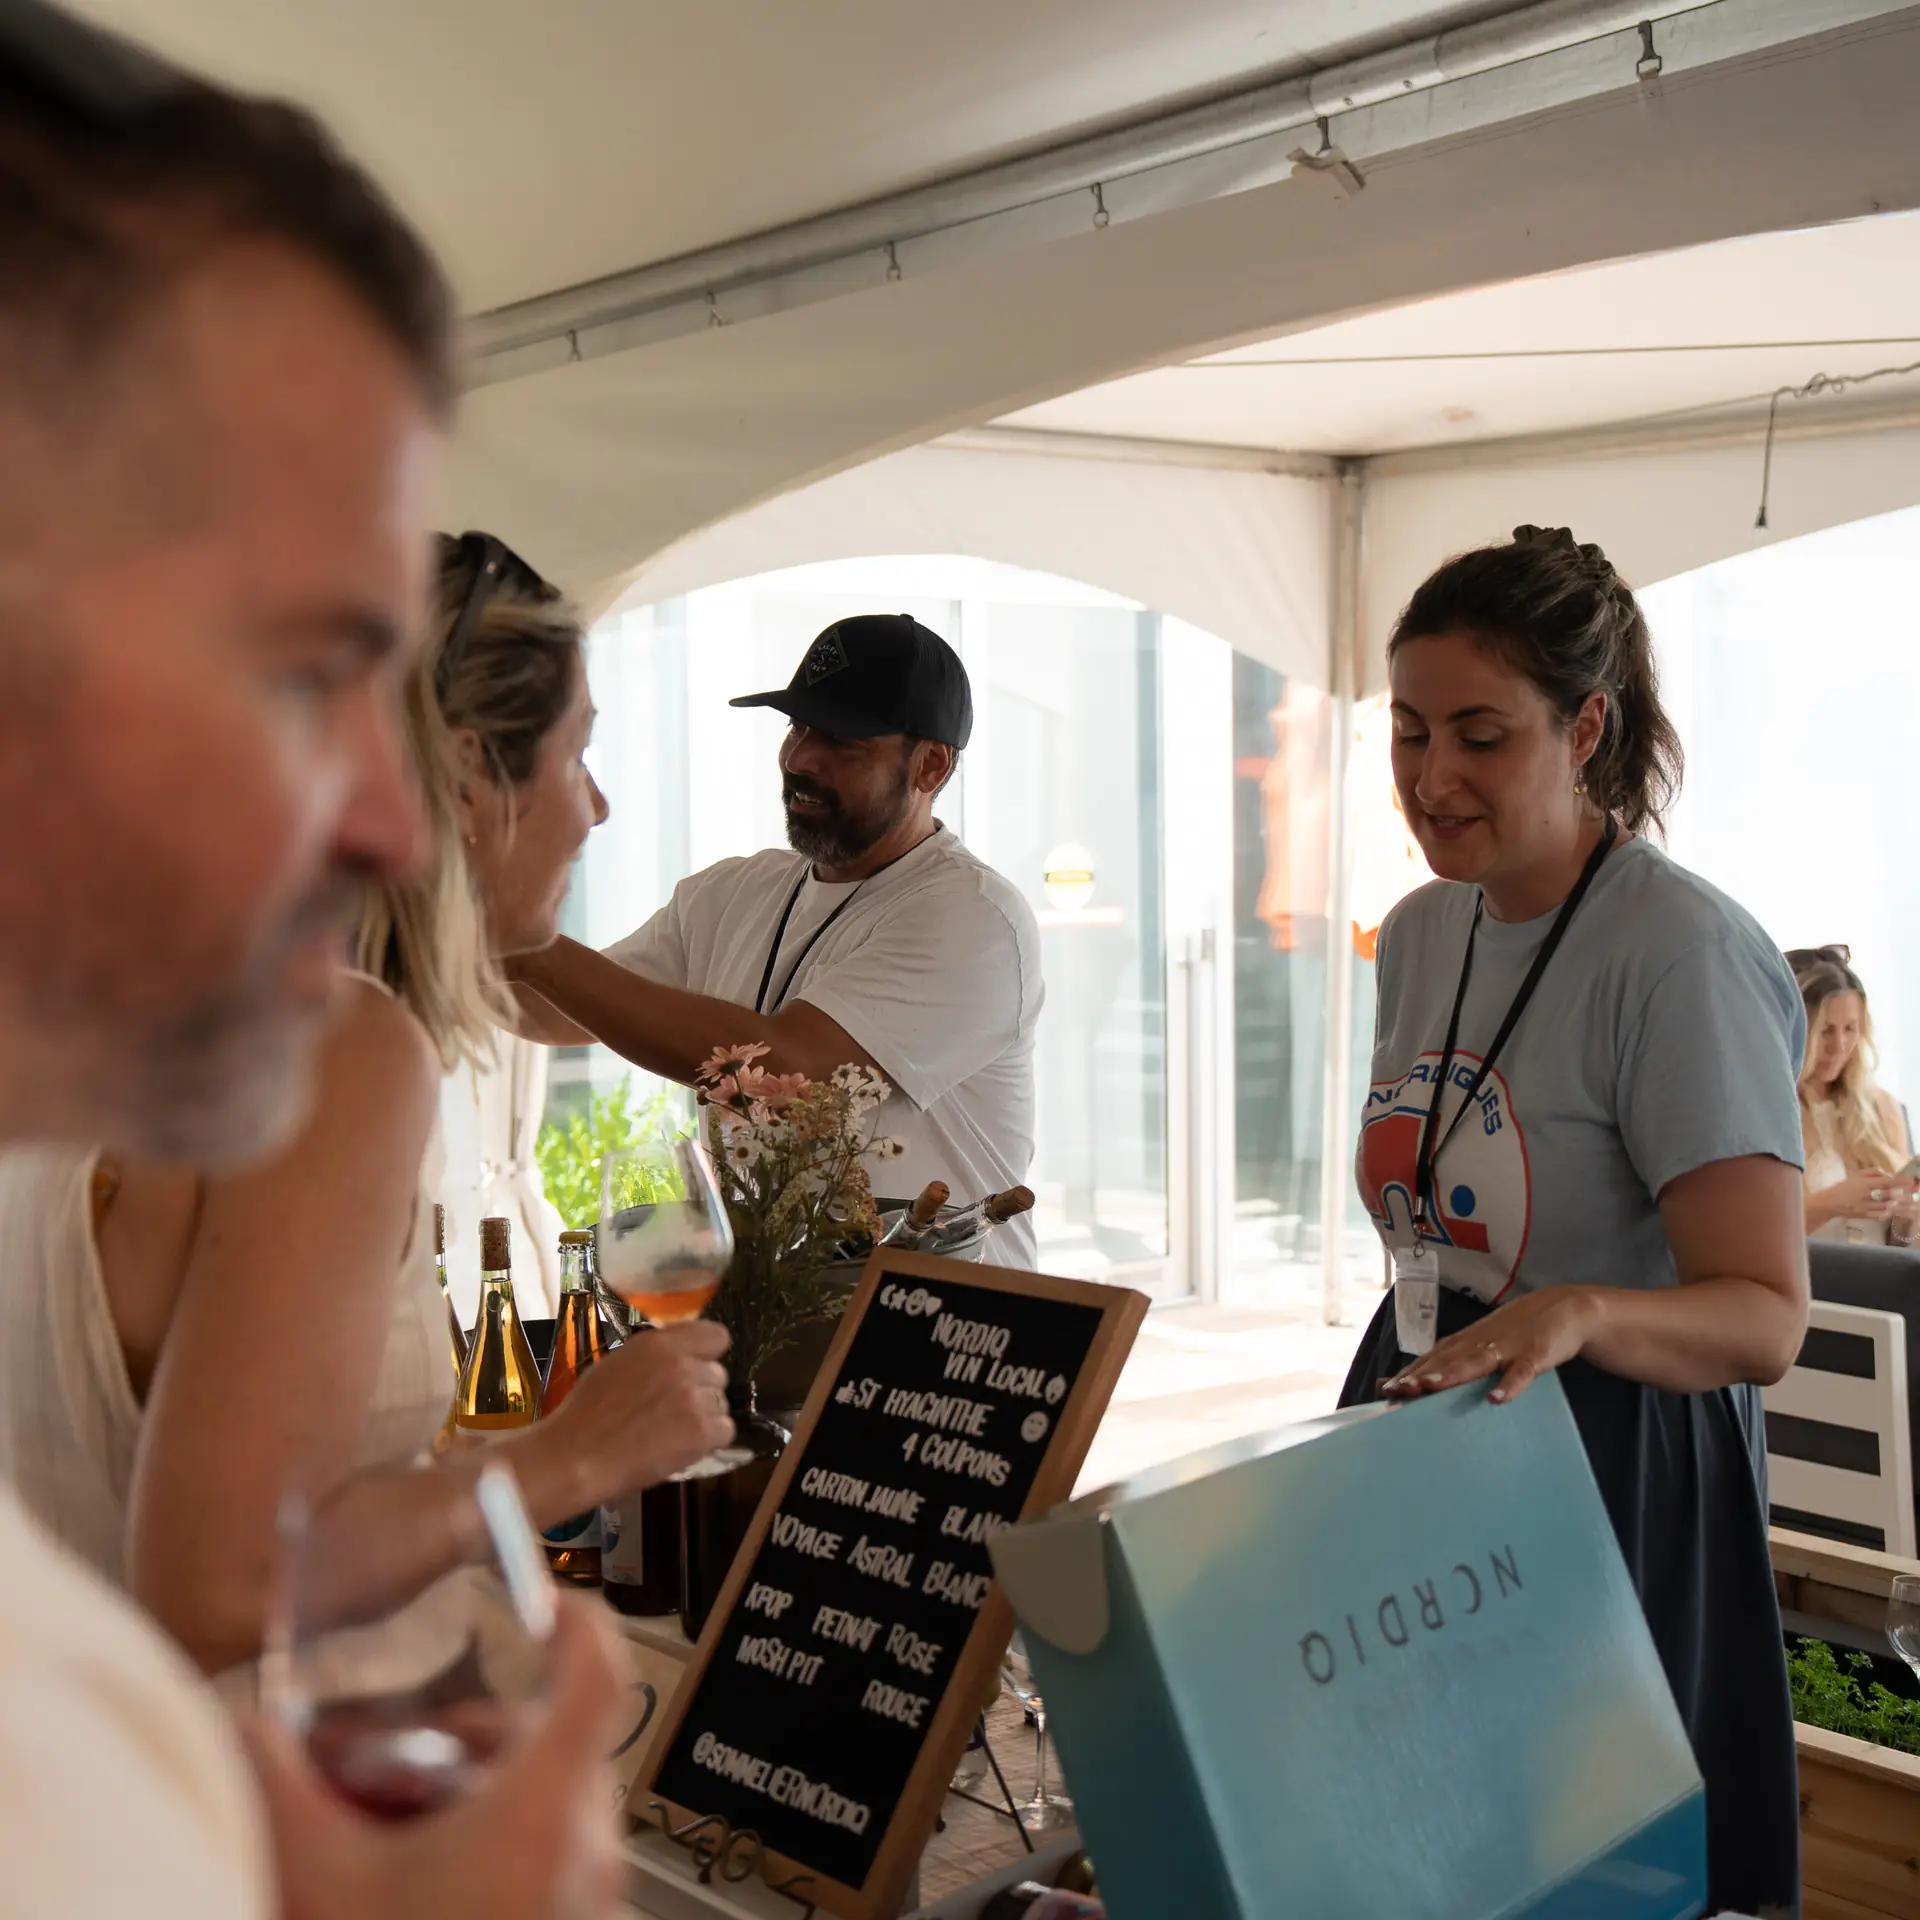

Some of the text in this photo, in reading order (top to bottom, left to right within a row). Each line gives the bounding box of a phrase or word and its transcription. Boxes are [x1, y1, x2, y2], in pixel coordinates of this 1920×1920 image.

[931, 1312, 1011, 1359] NORDIQ
[943, 1351, 1046, 1399] VIN LOCAL
[853, 1377, 995, 1437] ST HYACINTHE
[902, 1432, 1011, 1487] 4 COUPONS
[801, 1467, 869, 1507] CARTON
[864, 1485, 926, 1524] JAUNE
[771, 1513, 992, 1608] VOYAGE ASTRAL BLANC
[744, 1581, 793, 1620] KPOP
[884, 1622, 943, 1675] ROSE
[735, 1634, 930, 1728] MOSH PIT ROUGE
